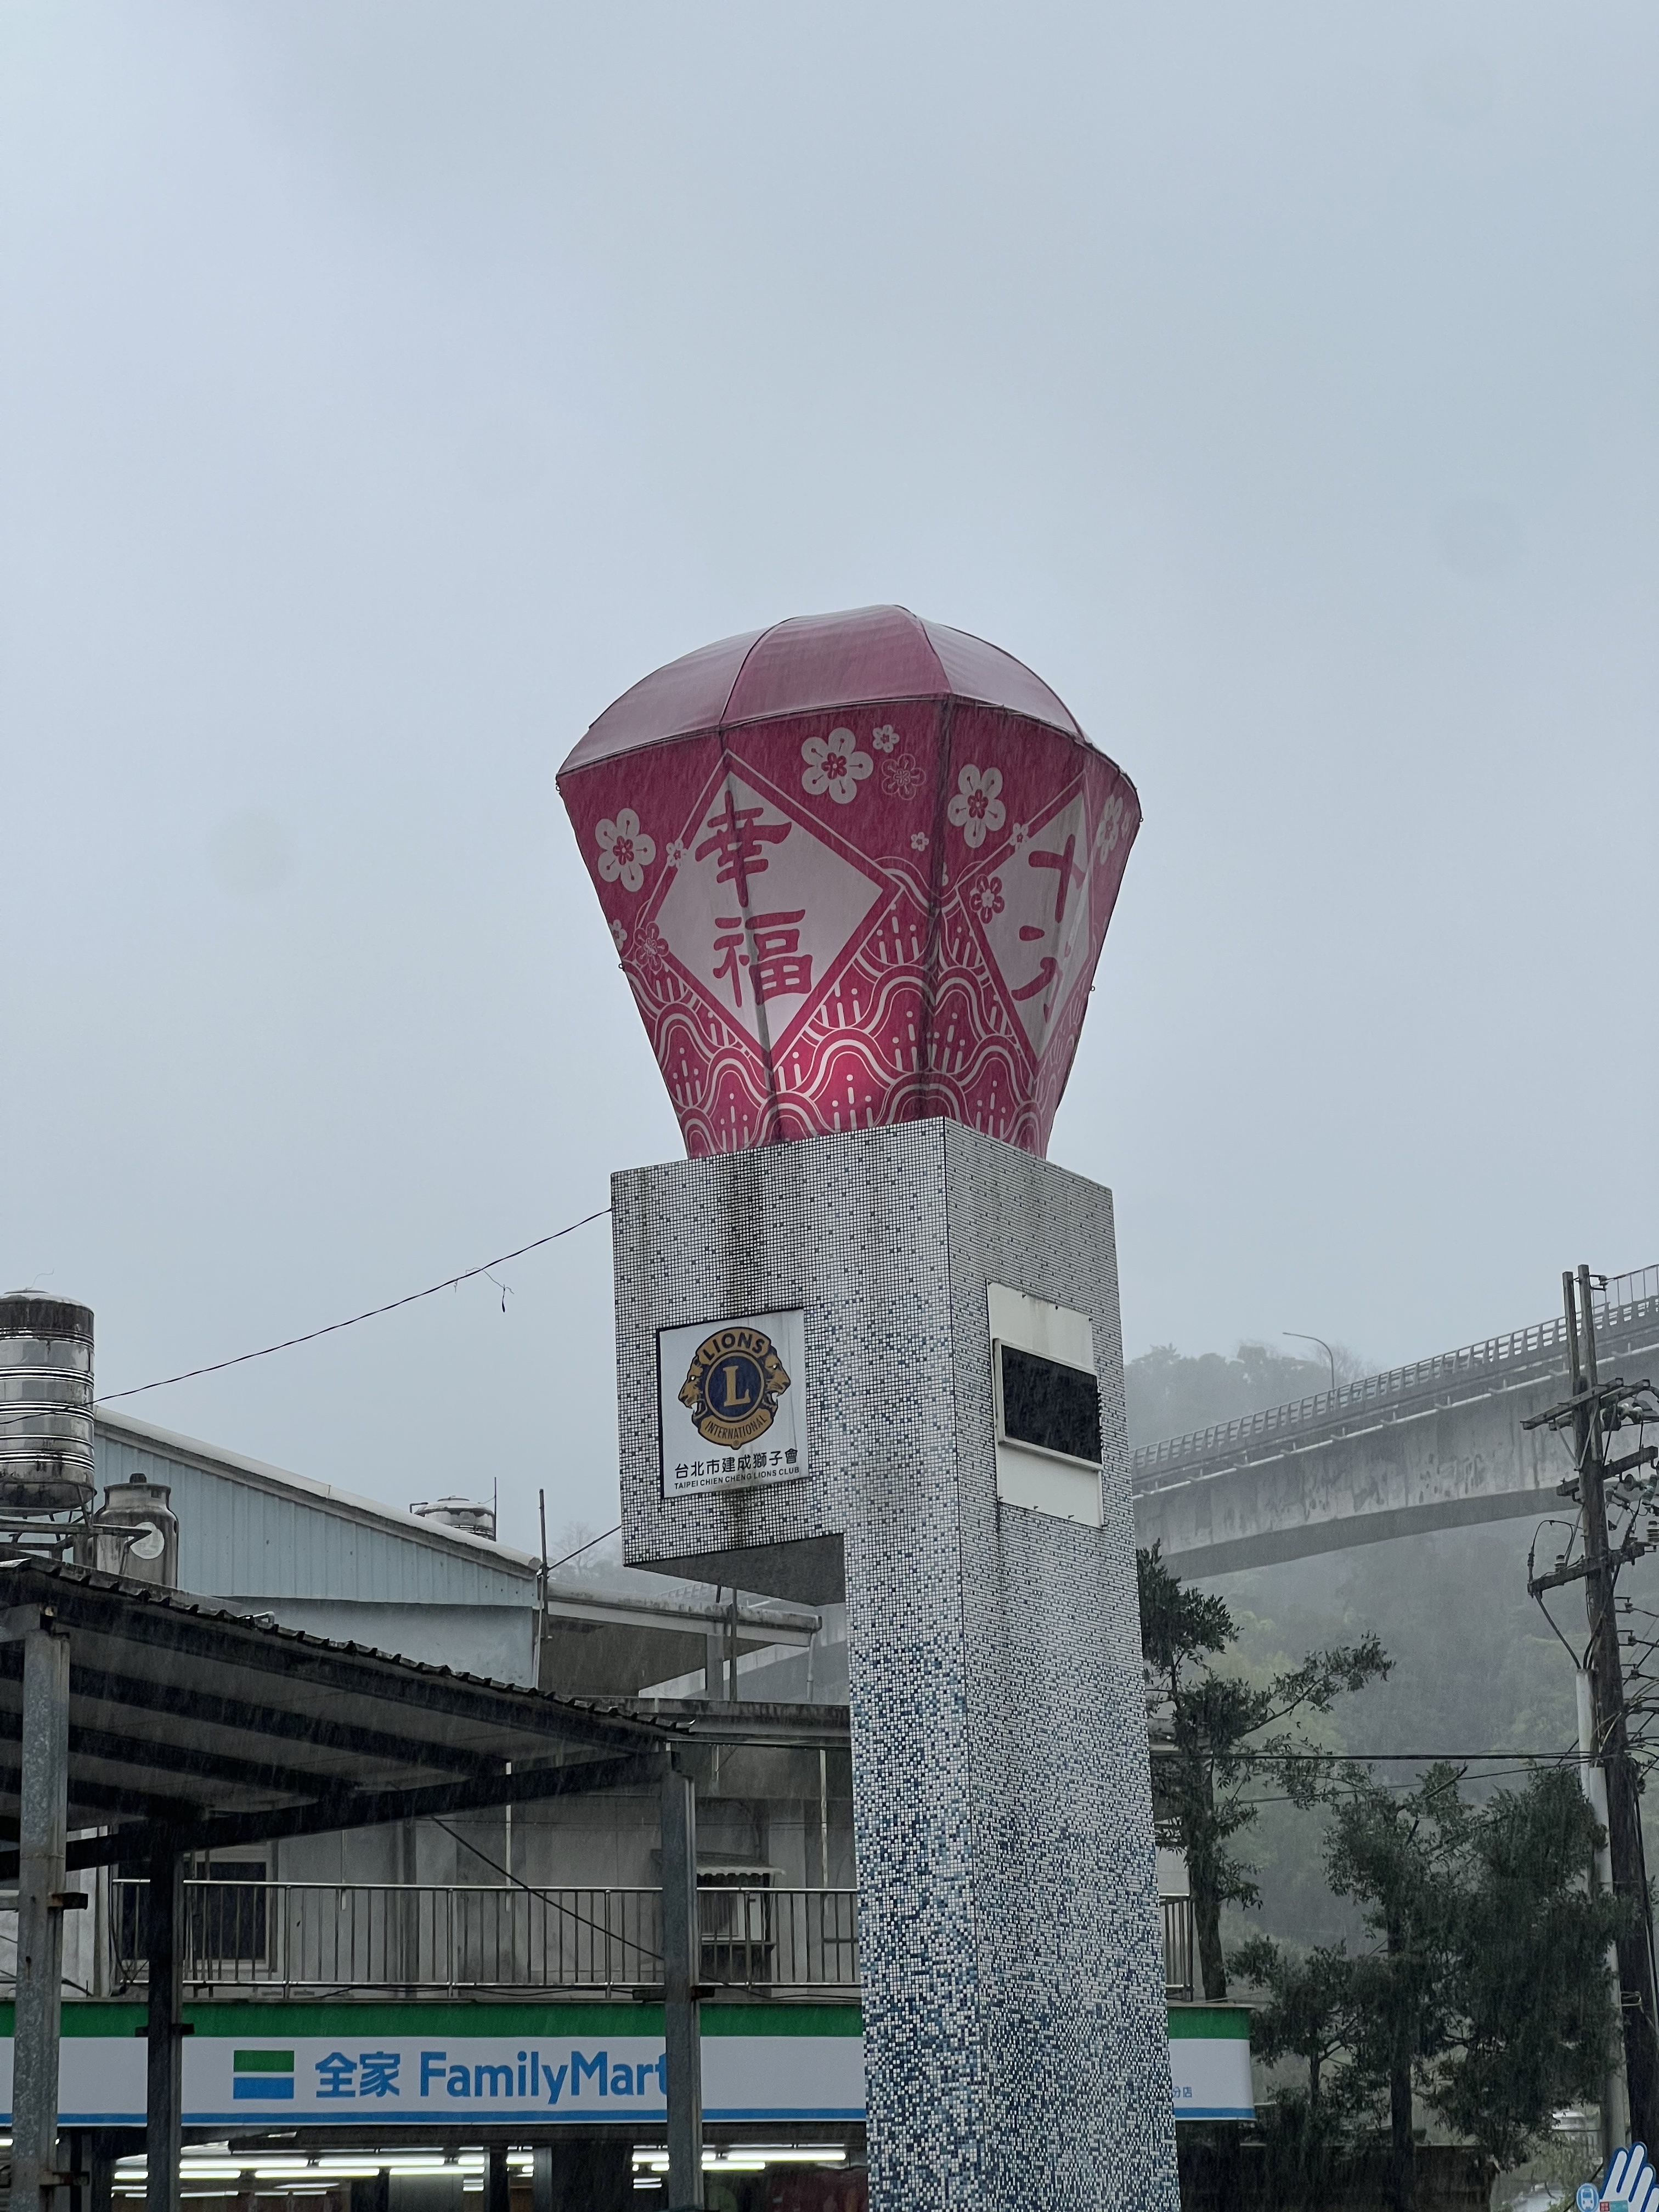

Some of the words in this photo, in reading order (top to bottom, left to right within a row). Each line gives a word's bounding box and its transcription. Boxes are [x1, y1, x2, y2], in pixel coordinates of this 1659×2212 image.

[695, 790, 813, 1008] 幸福
[702, 1332, 765, 1361] LIONS
[723, 1365, 751, 1407] L
[704, 1414, 768, 1440] INTERNATIONAL
[674, 1480, 698, 1489] TAIPEI
[700, 1477, 723, 1486] CHIEN
[725, 1472, 752, 1483] CHENG
[754, 1469, 777, 1479] LIONS
[779, 1466, 799, 1476] CLUB
[675, 1448, 798, 1479] 台北市建成獅子會
[315, 2051, 400, 2098] 全家
[420, 2051, 667, 2104] FamilyMart
